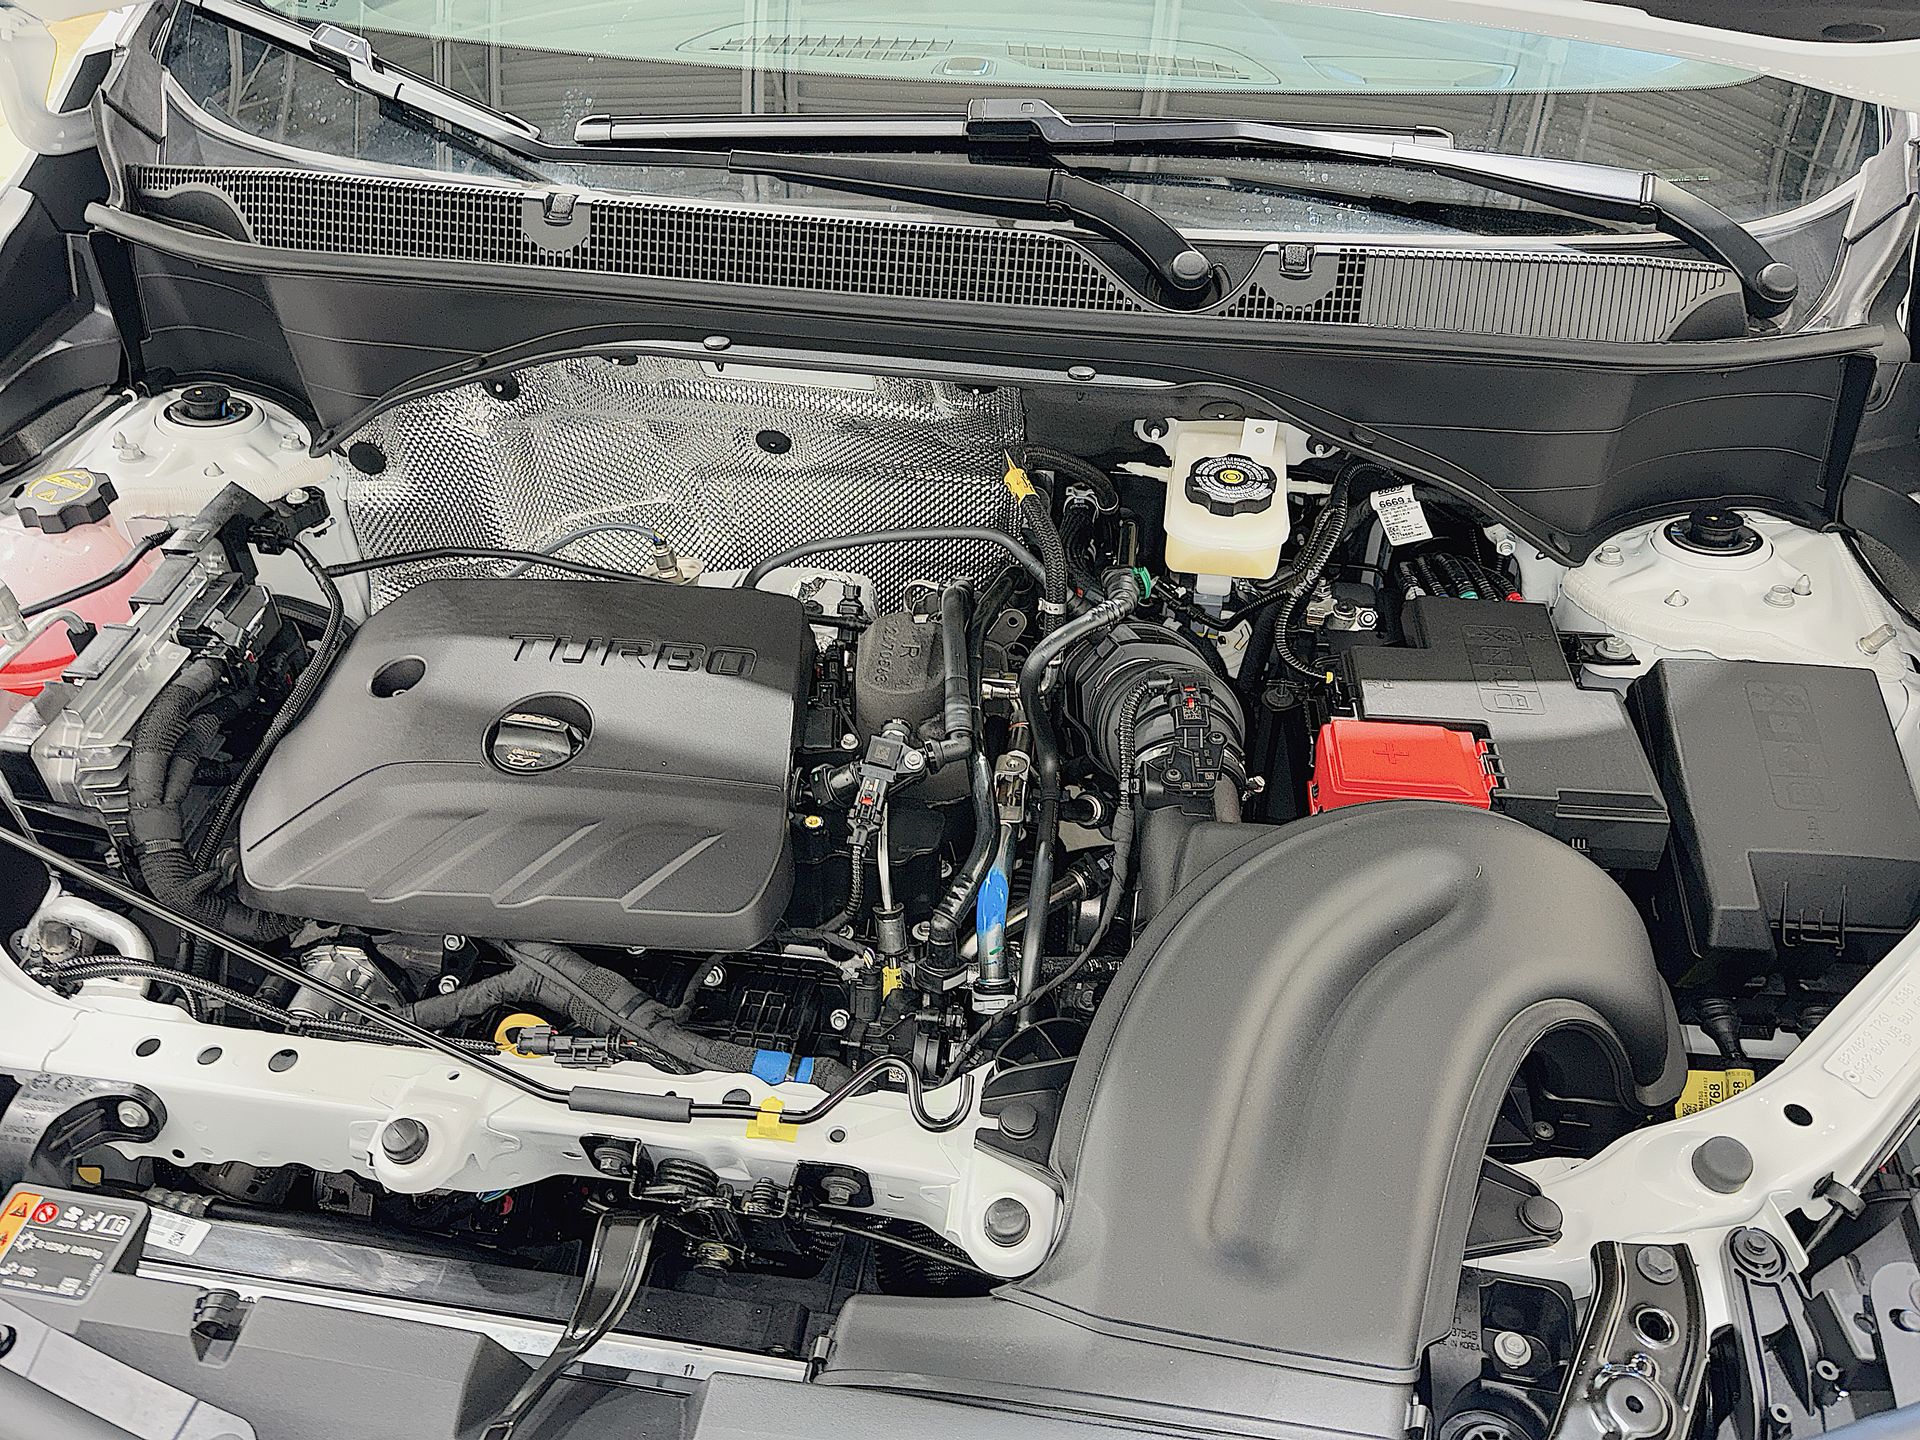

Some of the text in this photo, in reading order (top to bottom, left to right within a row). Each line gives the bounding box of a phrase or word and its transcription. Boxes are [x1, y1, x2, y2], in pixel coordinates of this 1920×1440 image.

[1379, 496, 1405, 508] 6669
[509, 633, 758, 676] TURBO
[900, 643, 921, 658] R
[1460, 1341, 1481, 1351] KOREA
